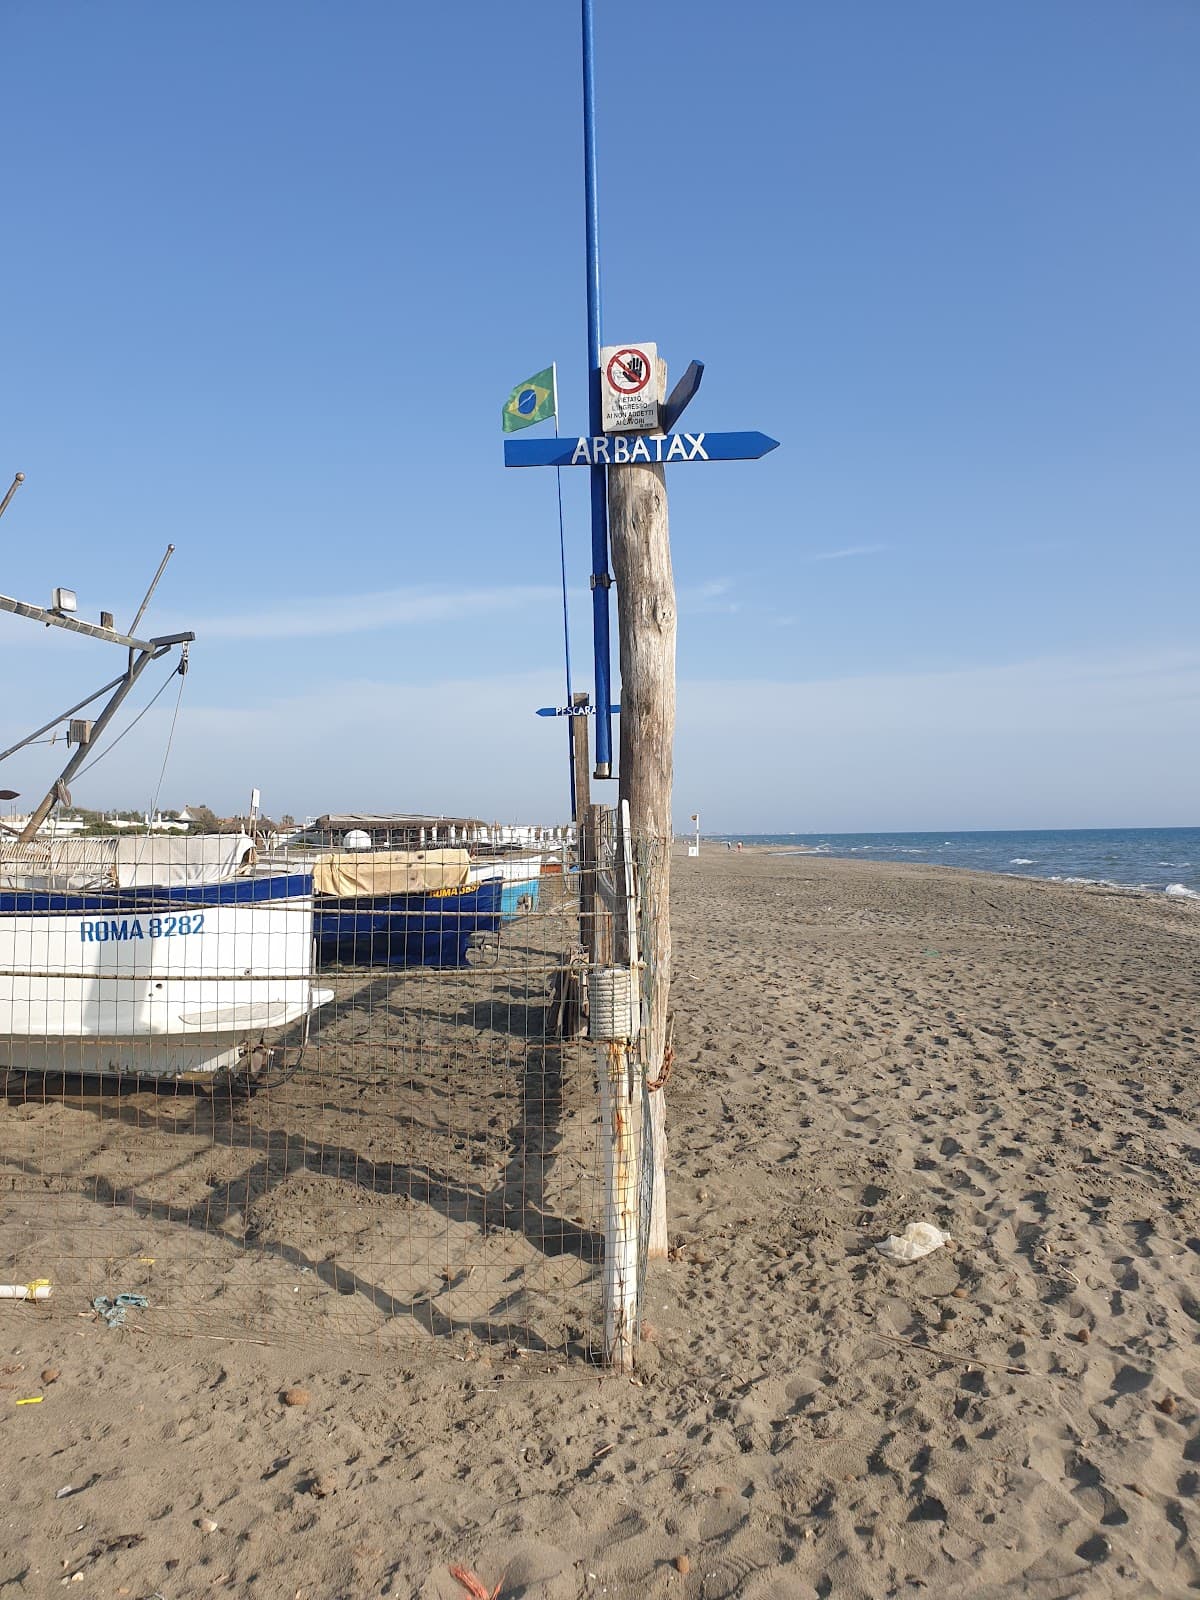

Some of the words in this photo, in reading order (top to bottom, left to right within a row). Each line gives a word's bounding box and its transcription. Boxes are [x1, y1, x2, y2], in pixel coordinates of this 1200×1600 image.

[571, 432, 709, 465] ARBATAX
[80, 919, 144, 942] ROMA
[148, 914, 205, 938] 8282
